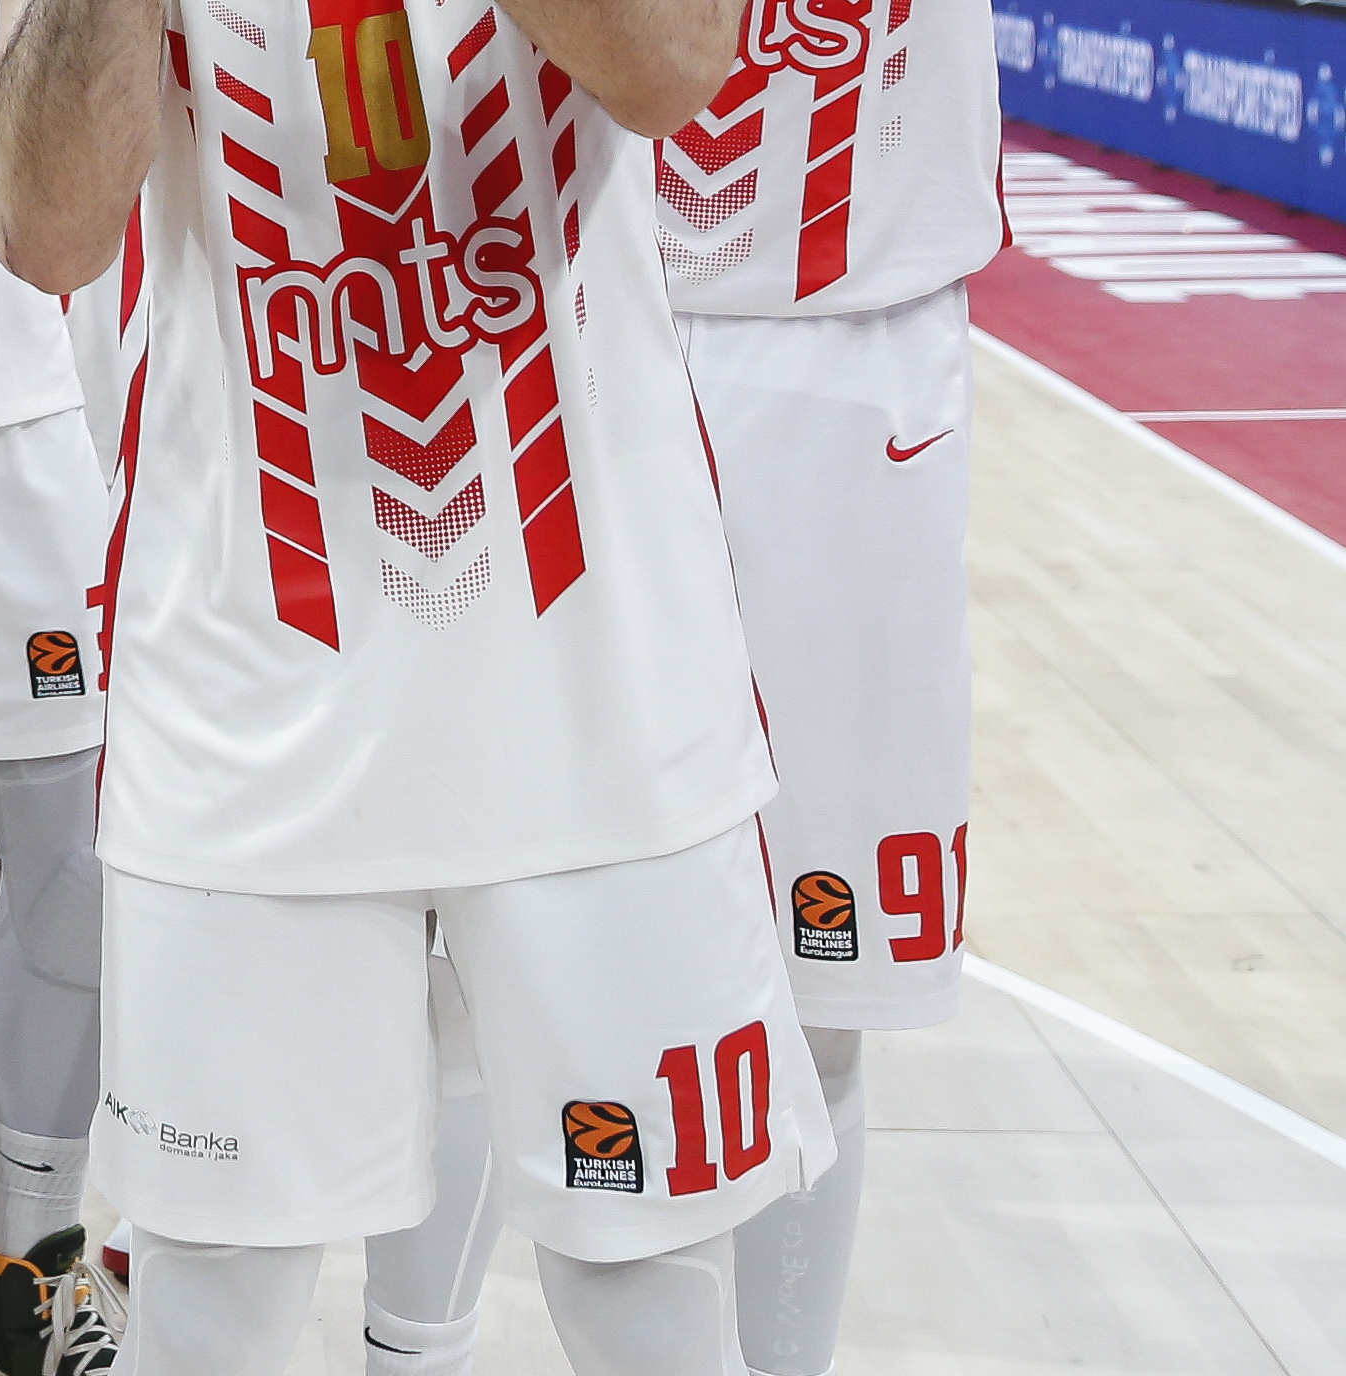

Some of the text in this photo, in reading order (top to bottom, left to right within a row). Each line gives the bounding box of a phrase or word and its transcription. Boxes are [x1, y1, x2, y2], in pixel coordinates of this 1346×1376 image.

[306, 9, 430, 184] 10
[245, 218, 539, 378] mts
[36, 673, 79, 684] TURKISH
[37, 681, 80, 691] AIRLINES
[799, 927, 852, 940] TURKISH
[800, 937, 852, 949] AIRLINES
[800, 946, 853, 959] EuroLeague
[654, 1019, 771, 1198] 10
[105, 1091, 238, 1152] AIK Banka
[214, 1151, 238, 1161] jaka
[574, 1157, 636, 1170] TURKISH
[575, 1168, 636, 1181] AIRLINES
[573, 1178, 636, 1190] EuroLeague
